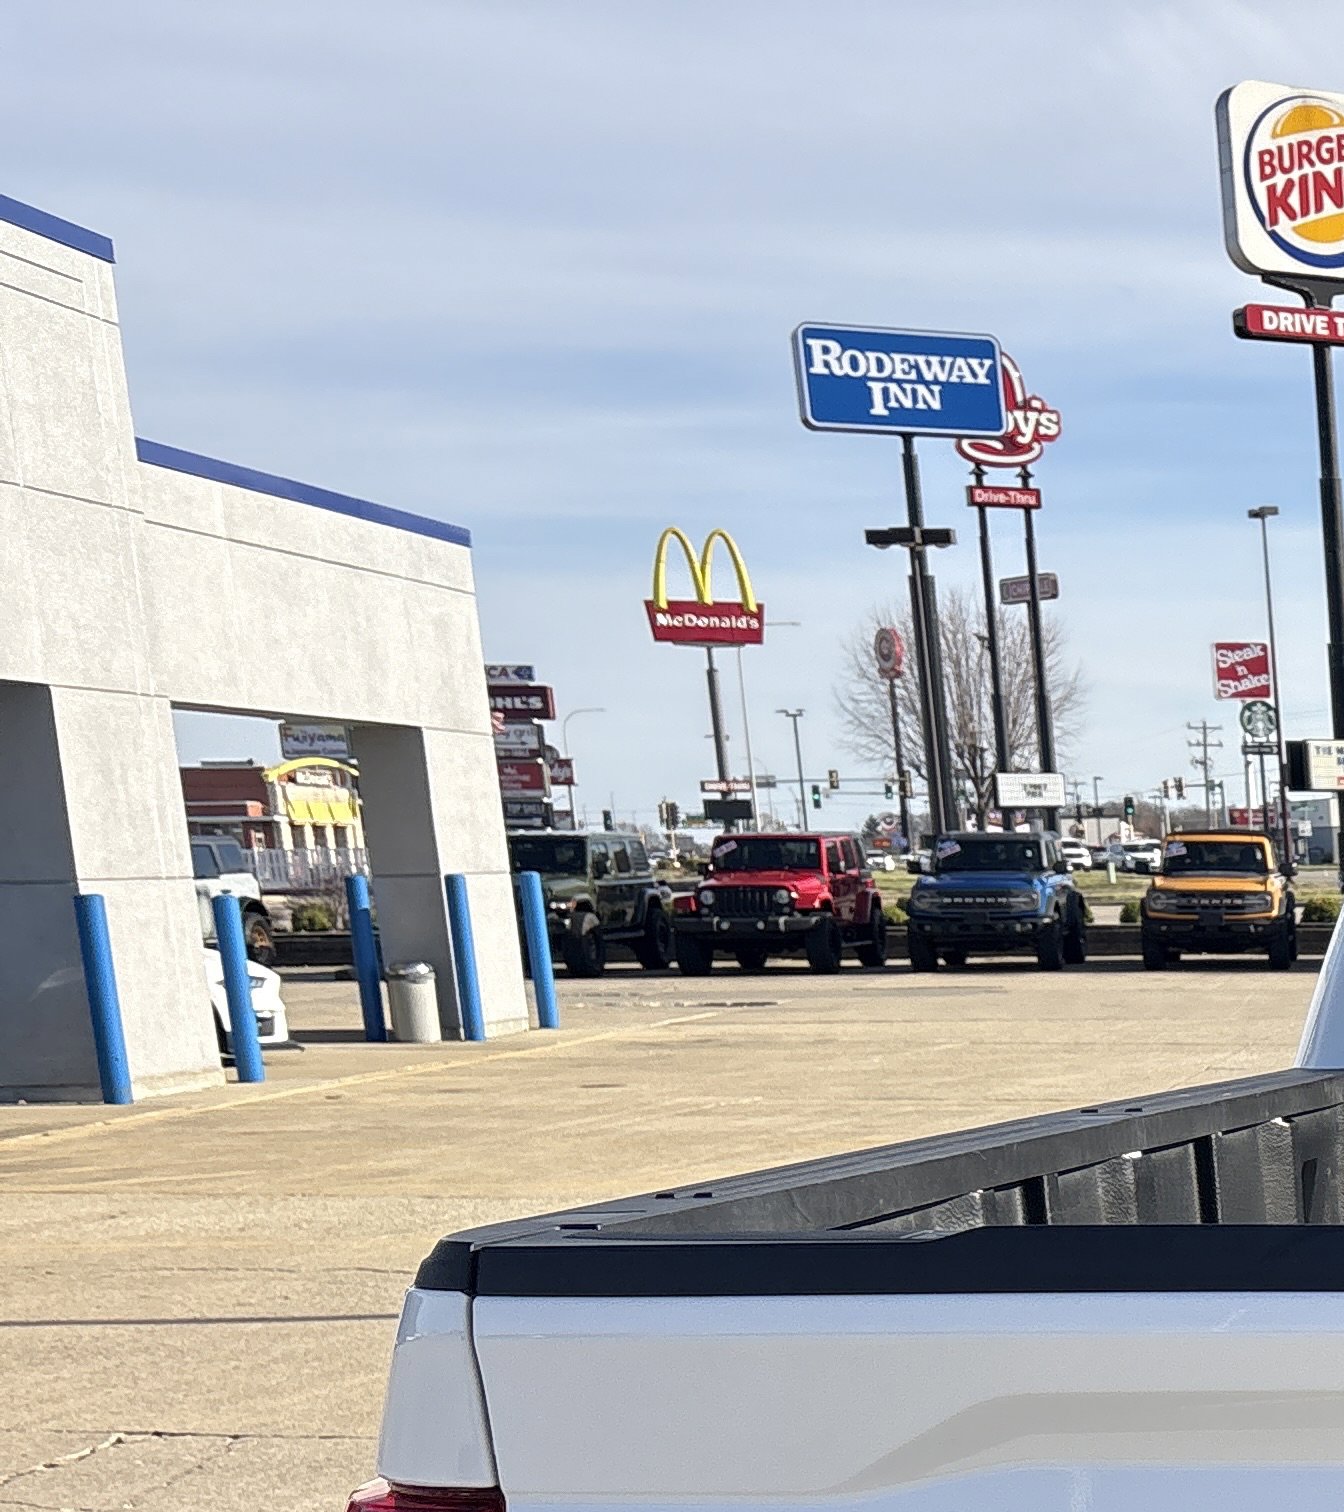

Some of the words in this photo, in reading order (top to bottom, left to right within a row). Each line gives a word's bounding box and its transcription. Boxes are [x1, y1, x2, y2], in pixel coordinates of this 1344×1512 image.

[1261, 309, 1330, 336] DRIVE
[867, 380, 942, 416] INN
[655, 612, 760, 629] McDonald's
[1217, 643, 1265, 668] Steak
[1219, 674, 1270, 698] Shake
